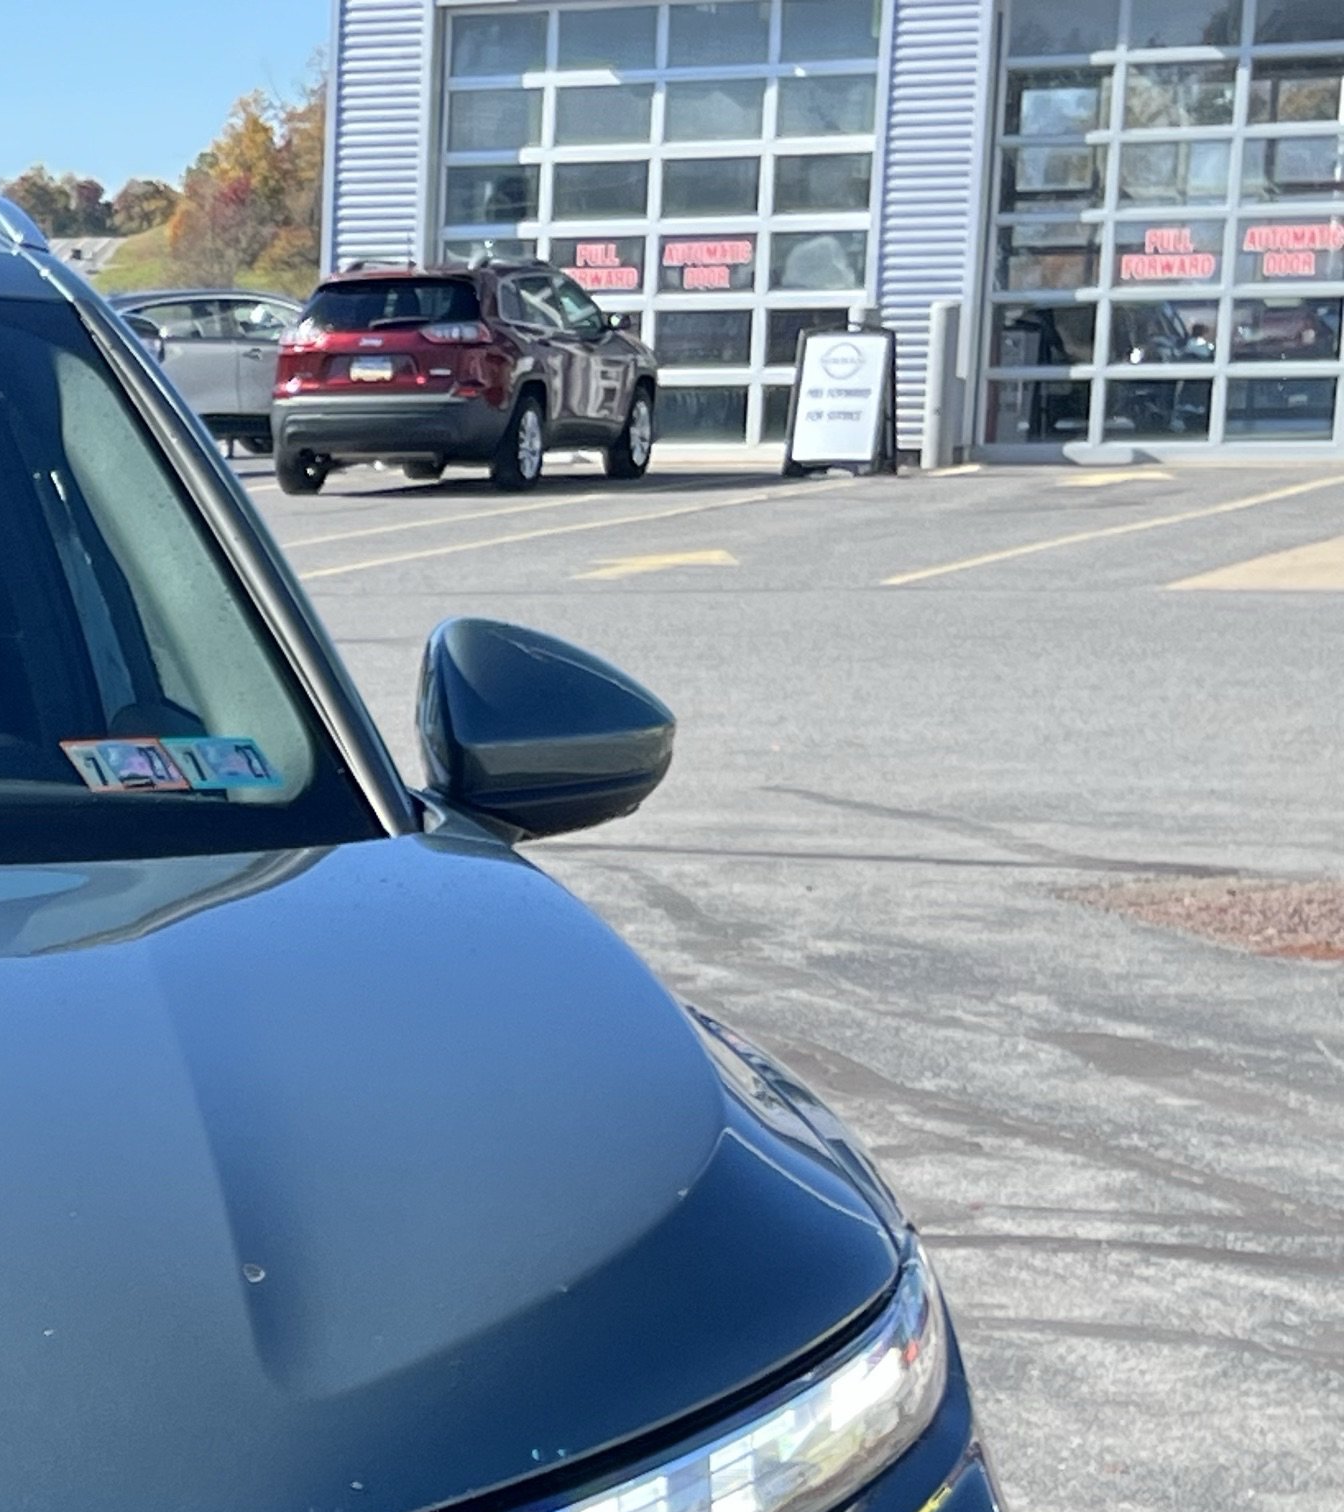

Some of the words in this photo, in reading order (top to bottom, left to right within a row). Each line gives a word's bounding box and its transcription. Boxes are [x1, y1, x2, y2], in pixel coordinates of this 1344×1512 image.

[1144, 228, 1195, 253] PULL
[576, 244, 620, 266] PULL
[663, 241, 752, 266] AUTOMATIC
[1263, 251, 1315, 276] DOOR
[564, 267, 639, 290] RWARD
[1121, 253, 1216, 280] FORWARD
